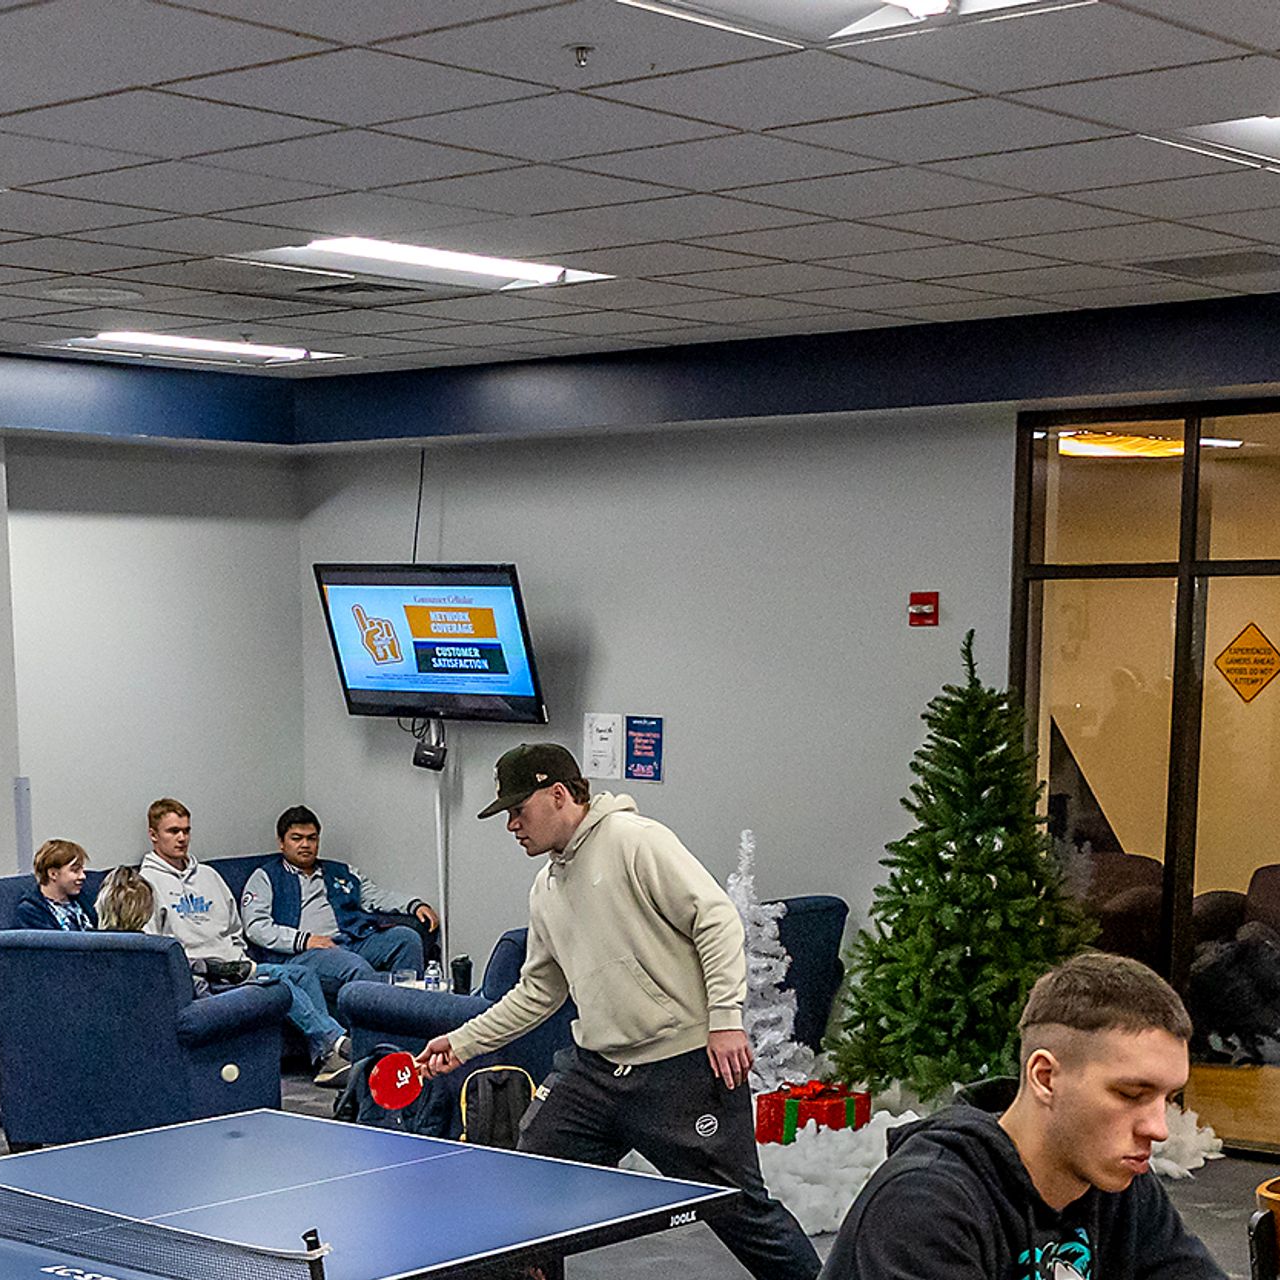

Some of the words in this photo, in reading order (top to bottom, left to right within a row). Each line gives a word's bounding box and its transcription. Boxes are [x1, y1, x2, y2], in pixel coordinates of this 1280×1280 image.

[435, 646, 481, 658] CUSTOMER
[431, 657, 490, 670] SATISFACTION
[669, 1210, 697, 1227] JOOLA
